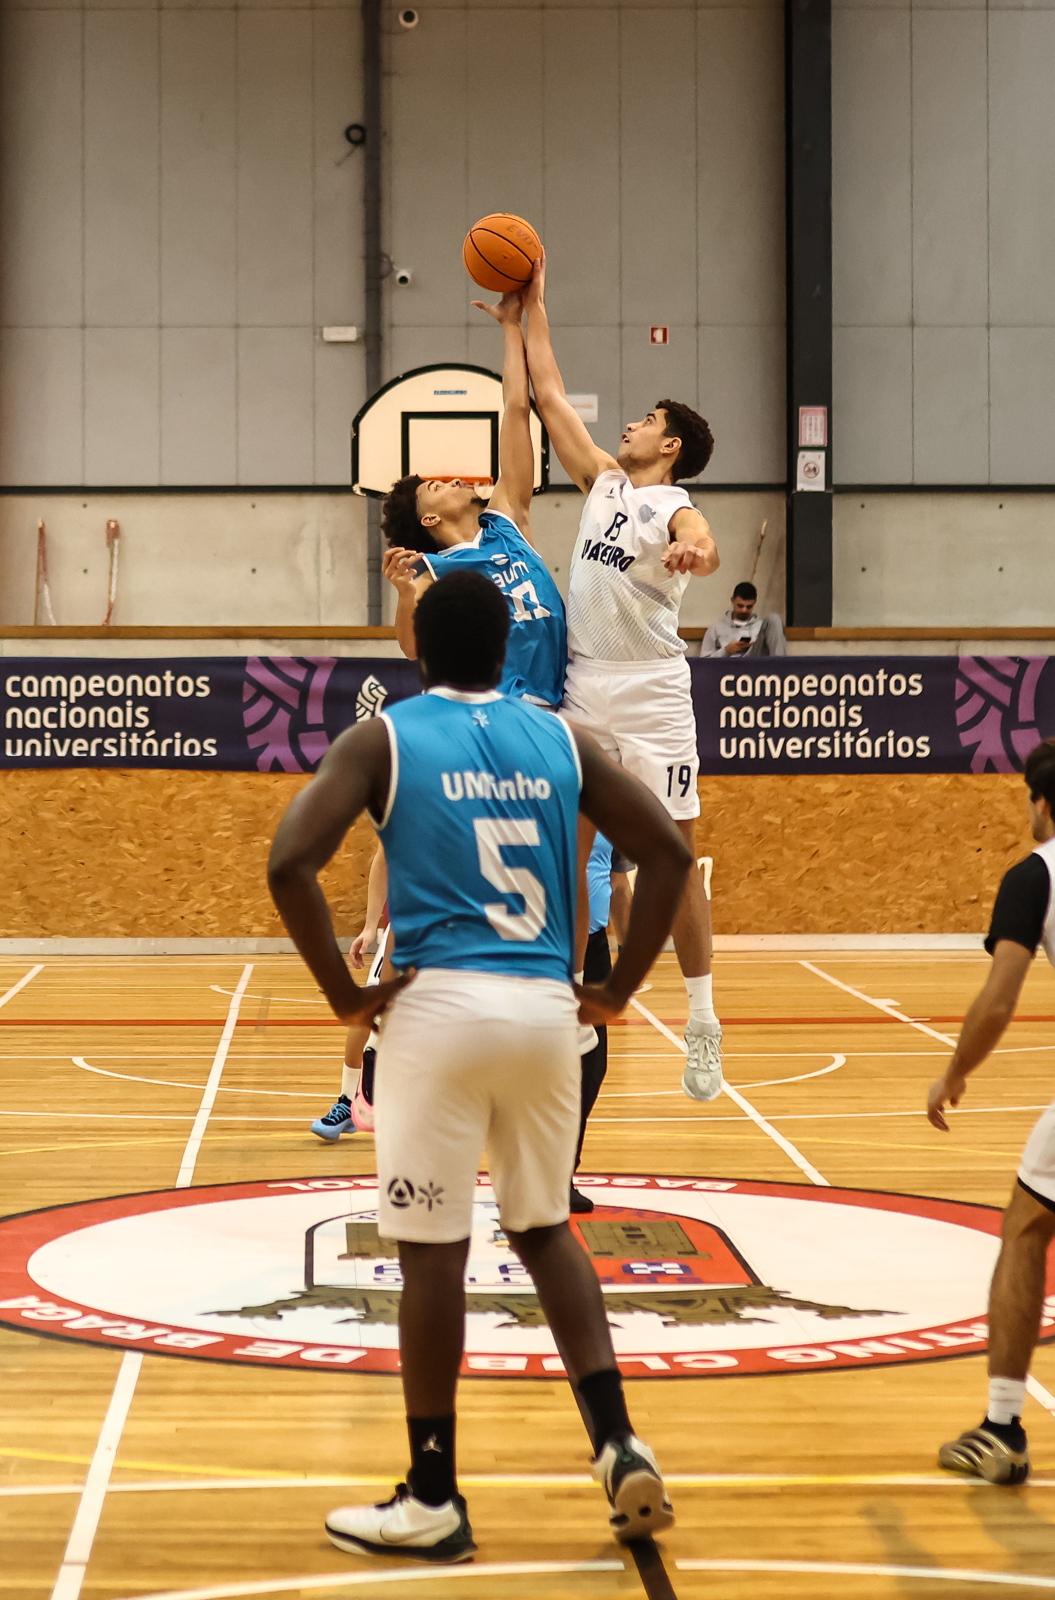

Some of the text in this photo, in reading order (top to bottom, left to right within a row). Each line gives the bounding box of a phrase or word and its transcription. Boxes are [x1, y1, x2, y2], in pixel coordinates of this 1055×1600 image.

[5, 670, 211, 704] campeonatos
[719, 668, 924, 703] campeonatos
[5, 700, 150, 729] nacionais
[719, 699, 863, 728] nacionais
[5, 729, 218, 757] universitários
[719, 728, 931, 759] universitários
[440, 770, 551, 802] UMinho
[666, 764, 692, 798] 19
[472, 817, 547, 942] 5
[0, 1295, 225, 1349] BRAGA
[233, 1341, 367, 1365] DE
